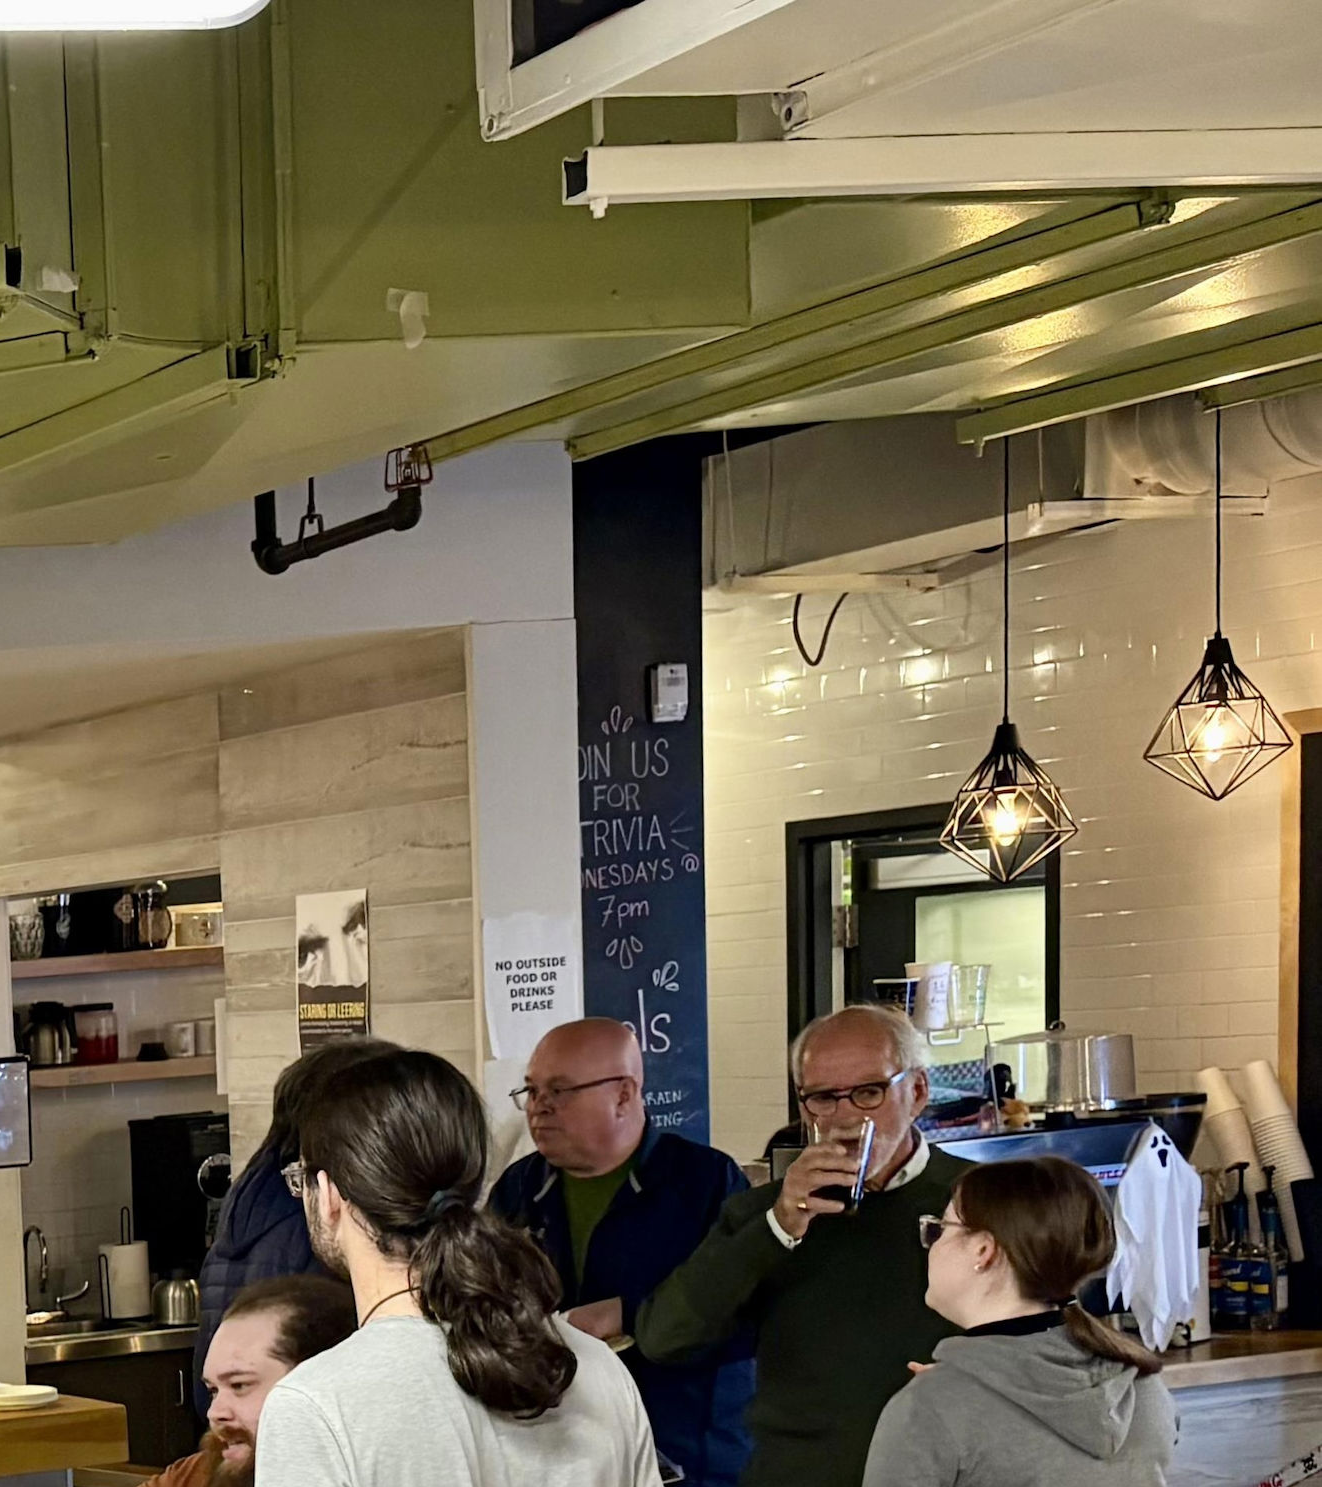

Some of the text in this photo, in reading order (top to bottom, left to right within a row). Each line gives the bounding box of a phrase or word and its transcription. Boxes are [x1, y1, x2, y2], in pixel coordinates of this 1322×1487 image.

[578, 738, 670, 781] OIN US
[593, 783, 641, 811] FOR
[581, 852, 700, 890] NESDAYS @
[597, 894, 649, 928] 7pm
[495, 956, 566, 971] NO OUTSIDE
[506, 971, 557, 985] FOOD OR
[510, 986, 555, 998] DRINKS
[337, 1002, 365, 1018] LEERING
[511, 1000, 554, 1012] PLEASE
